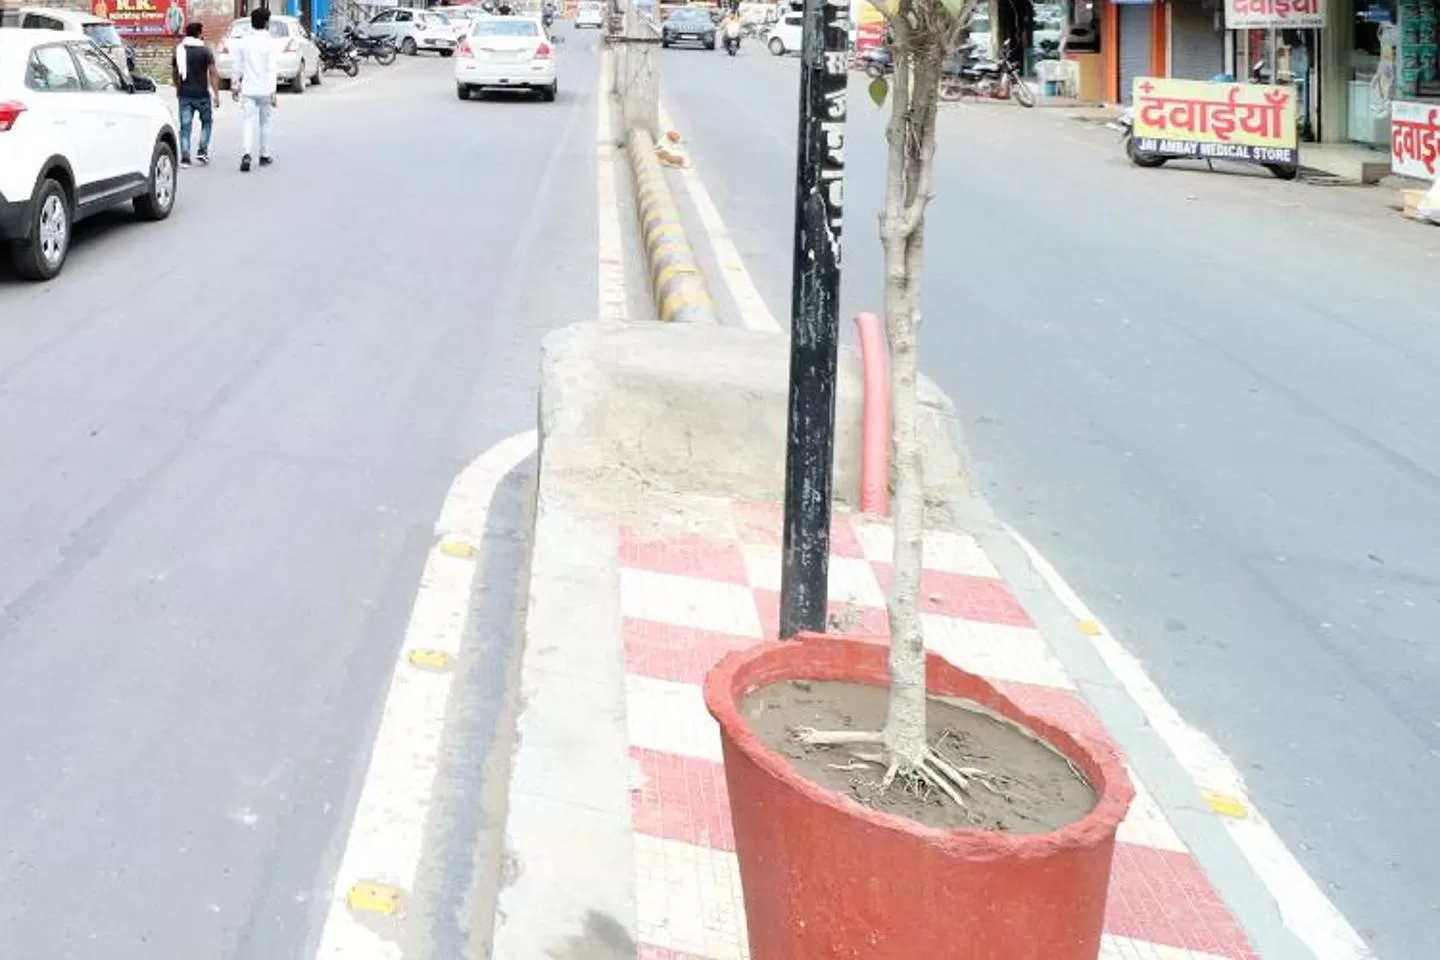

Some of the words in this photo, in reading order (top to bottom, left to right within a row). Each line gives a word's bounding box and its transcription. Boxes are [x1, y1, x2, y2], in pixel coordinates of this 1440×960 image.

[1139, 87, 1289, 141] दवाईयाँ
[1139, 139, 1157, 151] JAI
[1159, 141, 1199, 154] AMBAY
[1201, 144, 1251, 159] MEDICAL
[1253, 148, 1291, 162] STORE
[1392, 109, 1440, 174] दवाई
